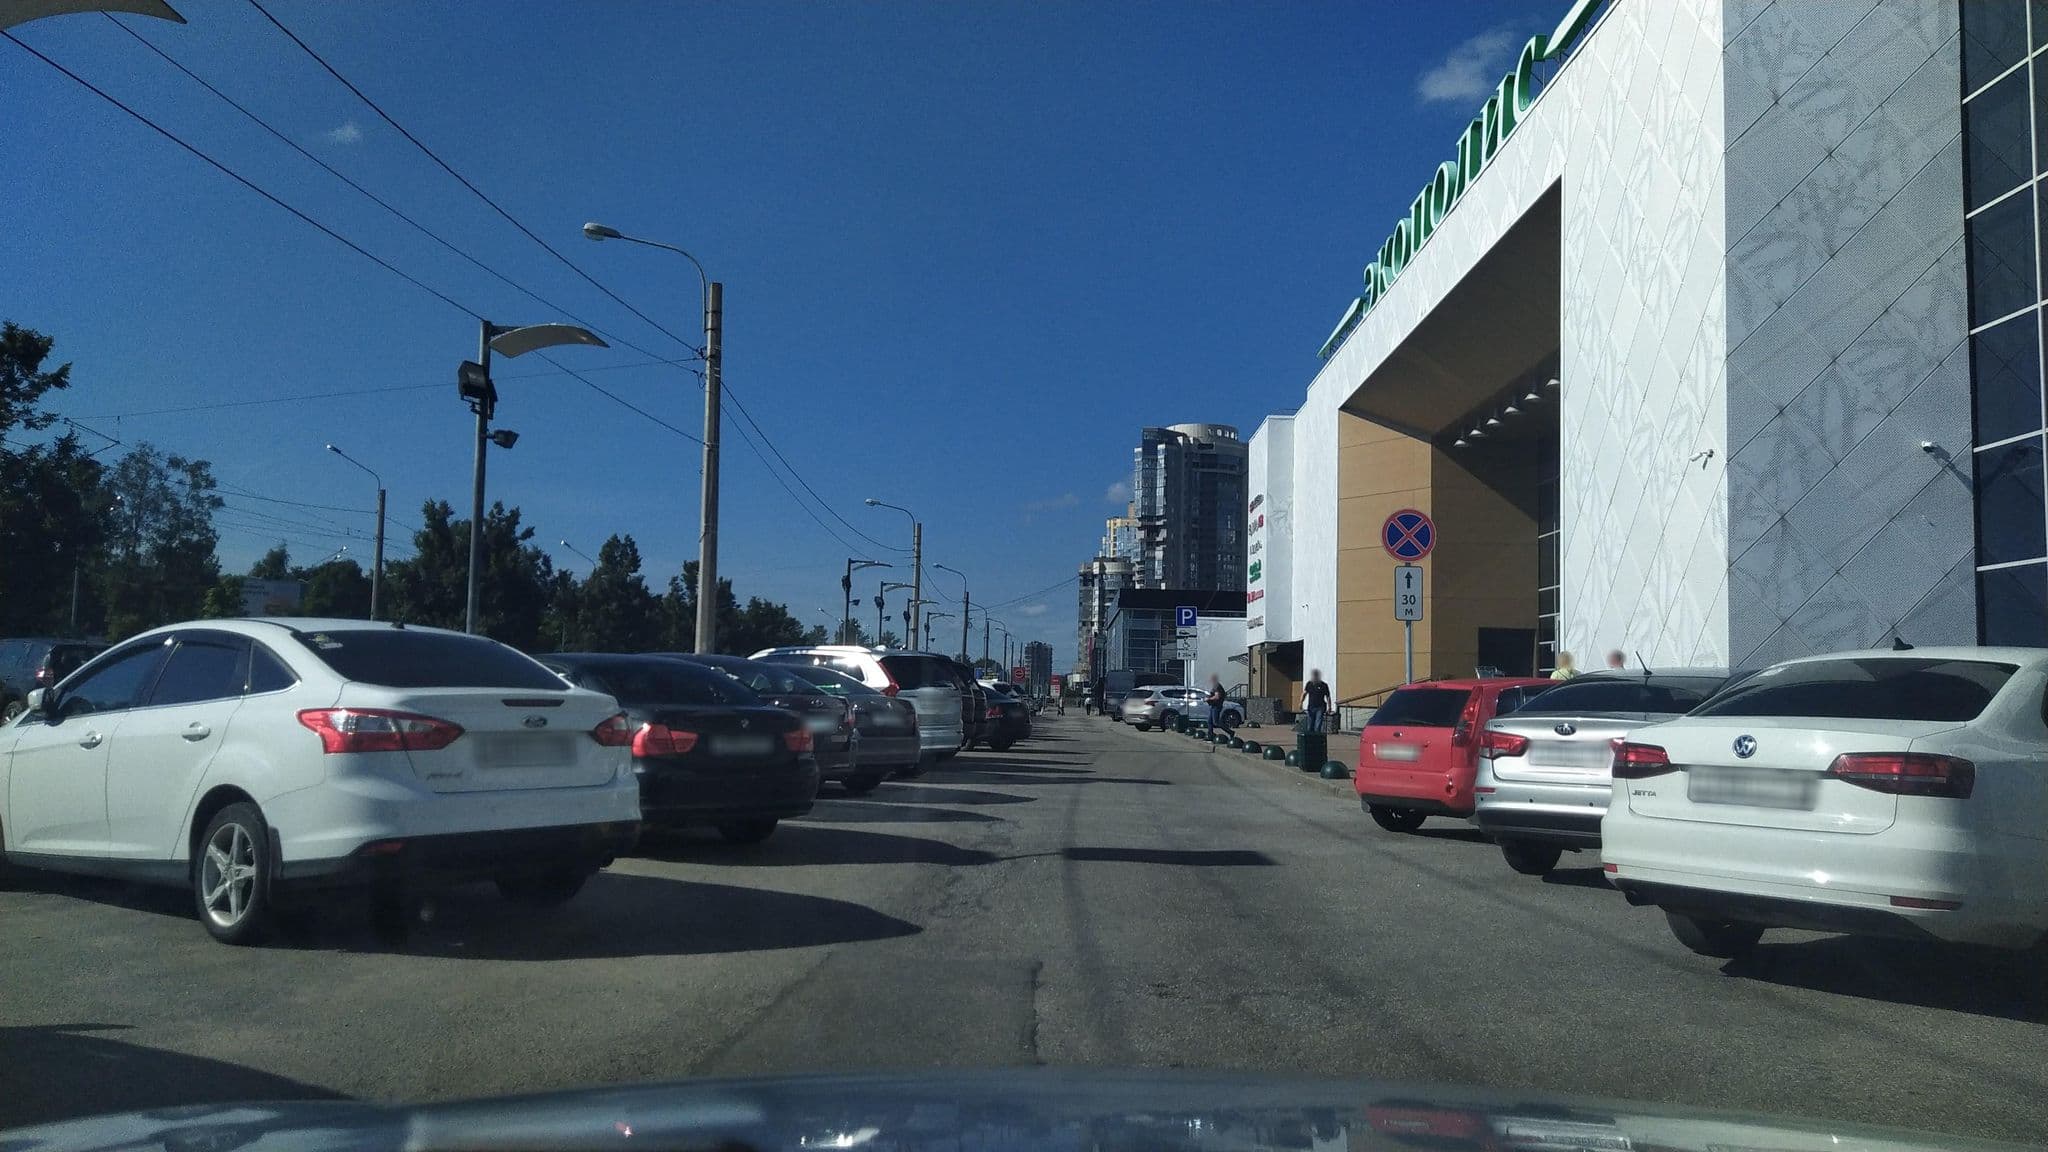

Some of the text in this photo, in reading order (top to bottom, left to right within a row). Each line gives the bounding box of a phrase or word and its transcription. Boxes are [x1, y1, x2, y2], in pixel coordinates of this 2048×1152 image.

[1401, 594, 1416, 605] 30
[1181, 609, 1193, 625] P
[1632, 789, 1657, 797] JETTA
